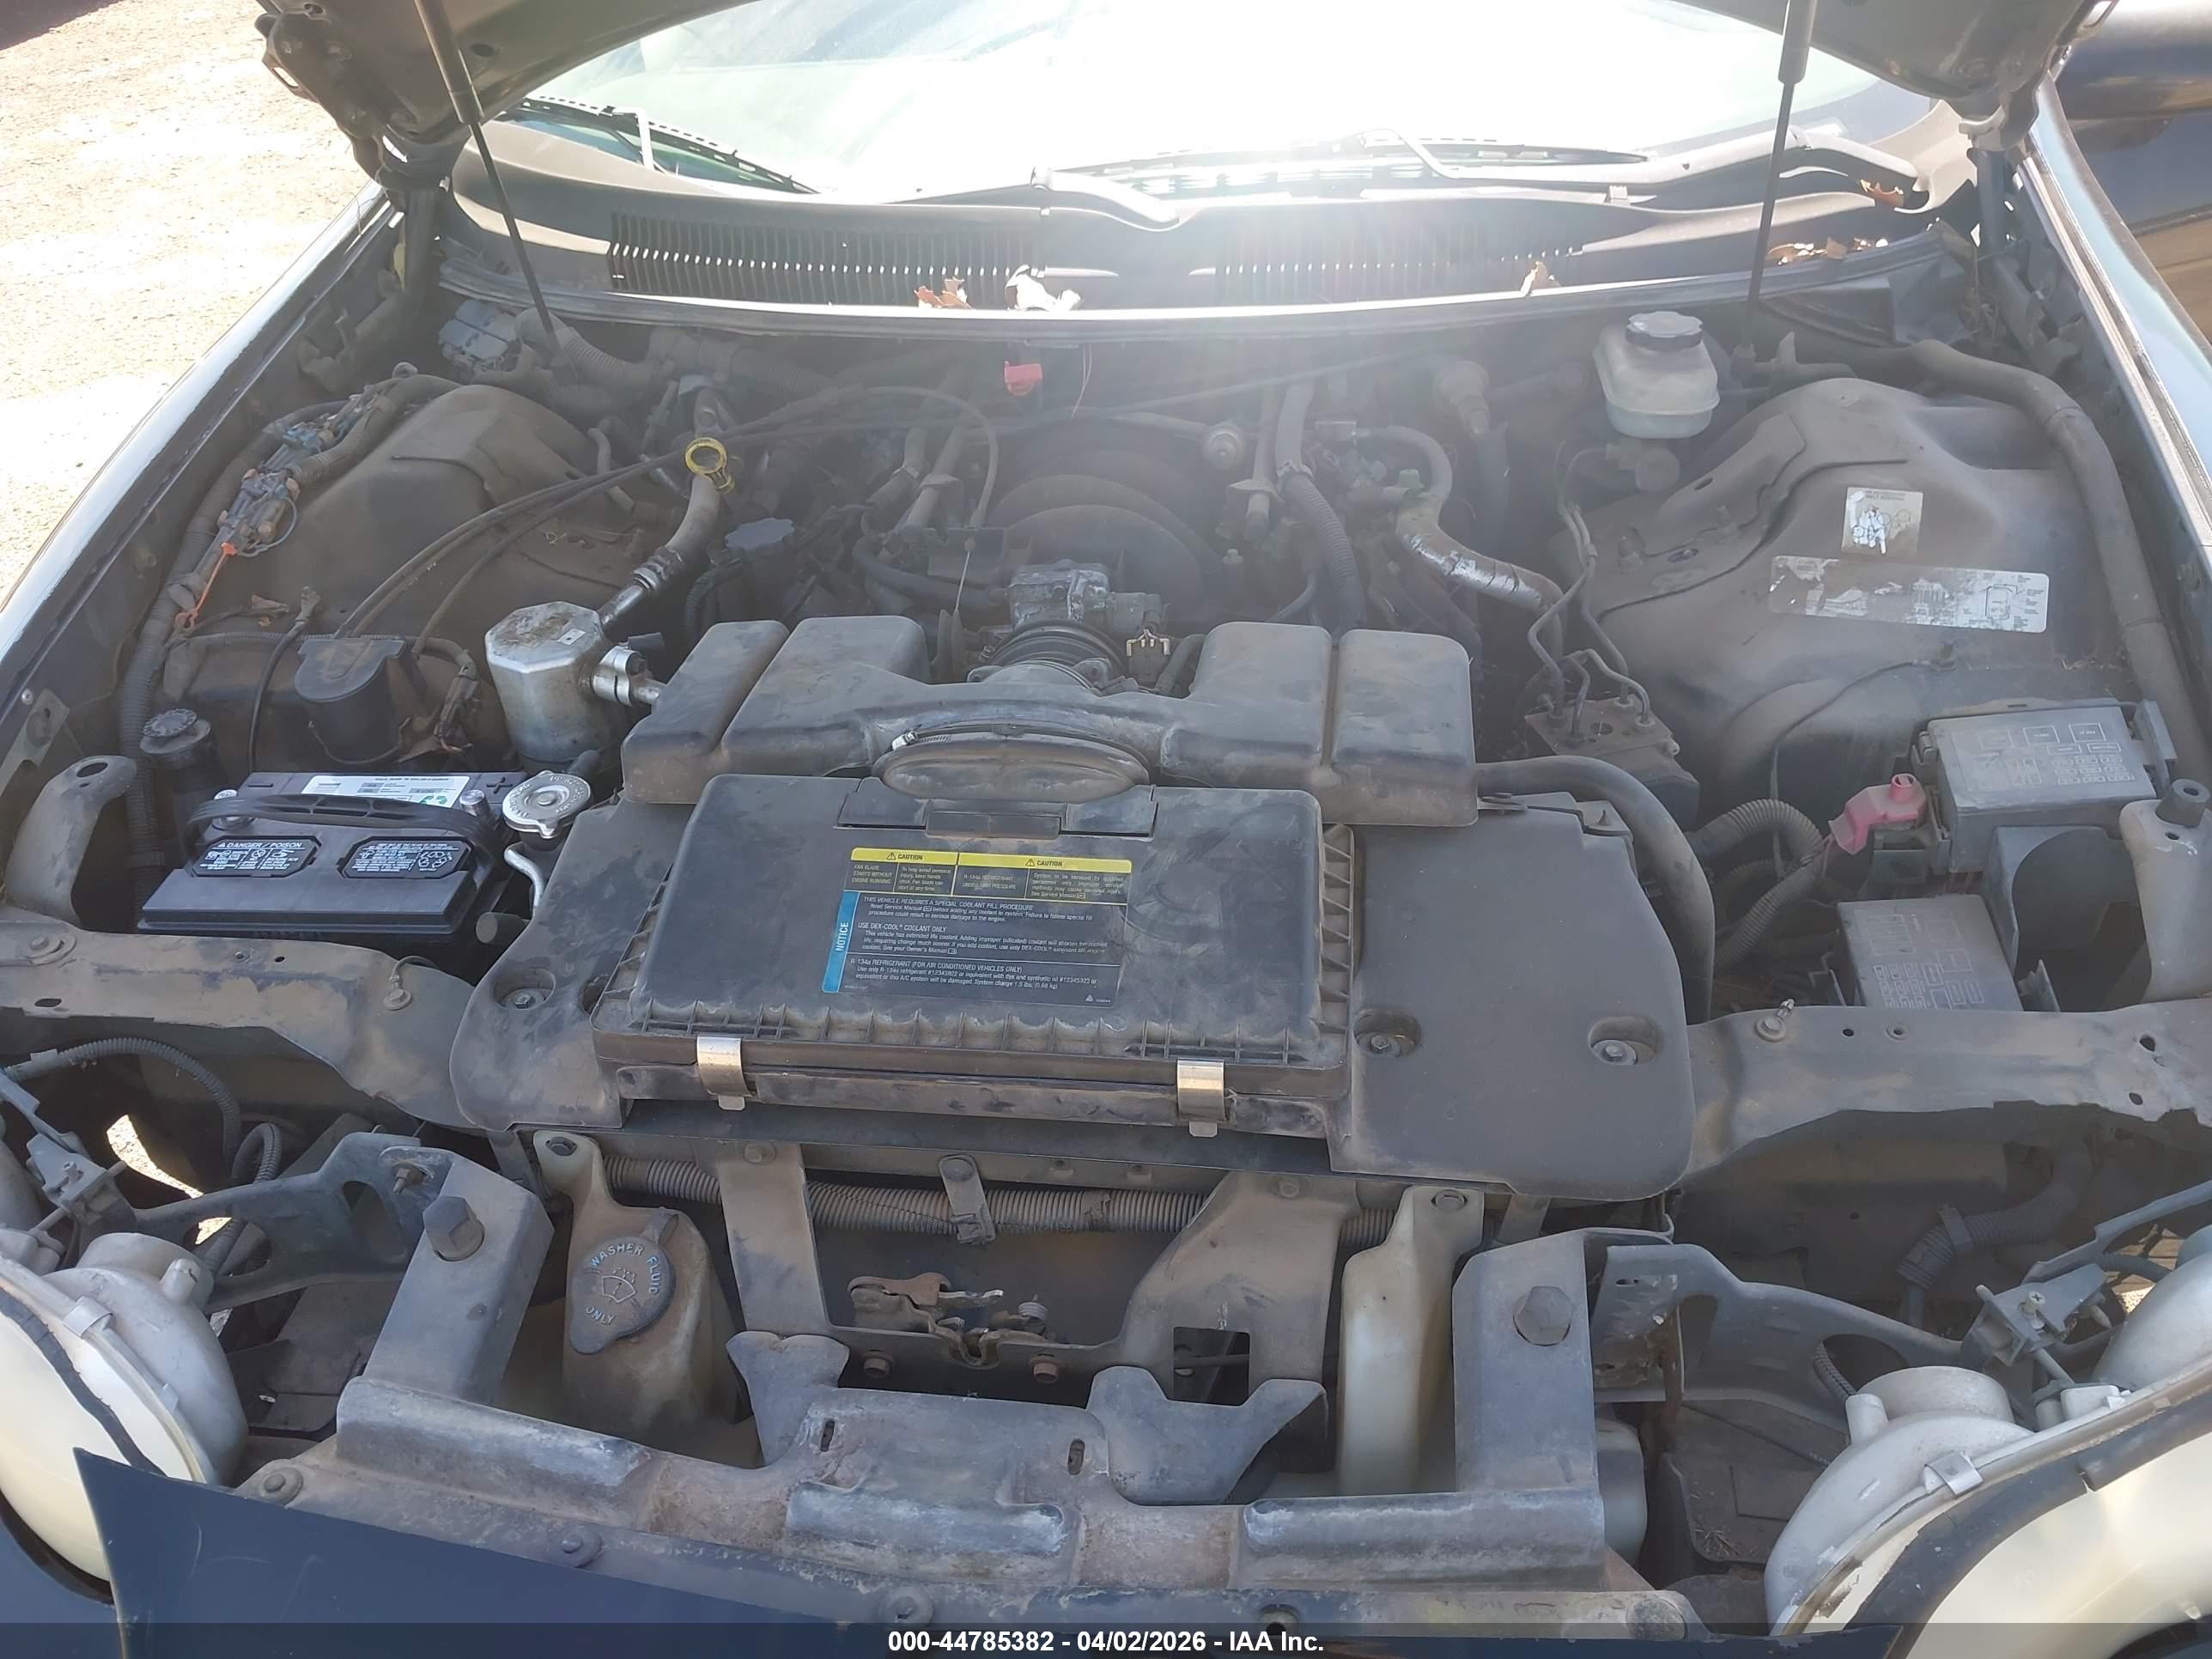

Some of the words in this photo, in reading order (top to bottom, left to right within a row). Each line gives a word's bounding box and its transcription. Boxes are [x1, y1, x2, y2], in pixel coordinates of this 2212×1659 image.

[835, 921, 849, 951] NOTICE
[591, 1243, 643, 1267] WASHER
[647, 1256, 660, 1294] FLUID
[586, 1305, 615, 1325] ONLY
